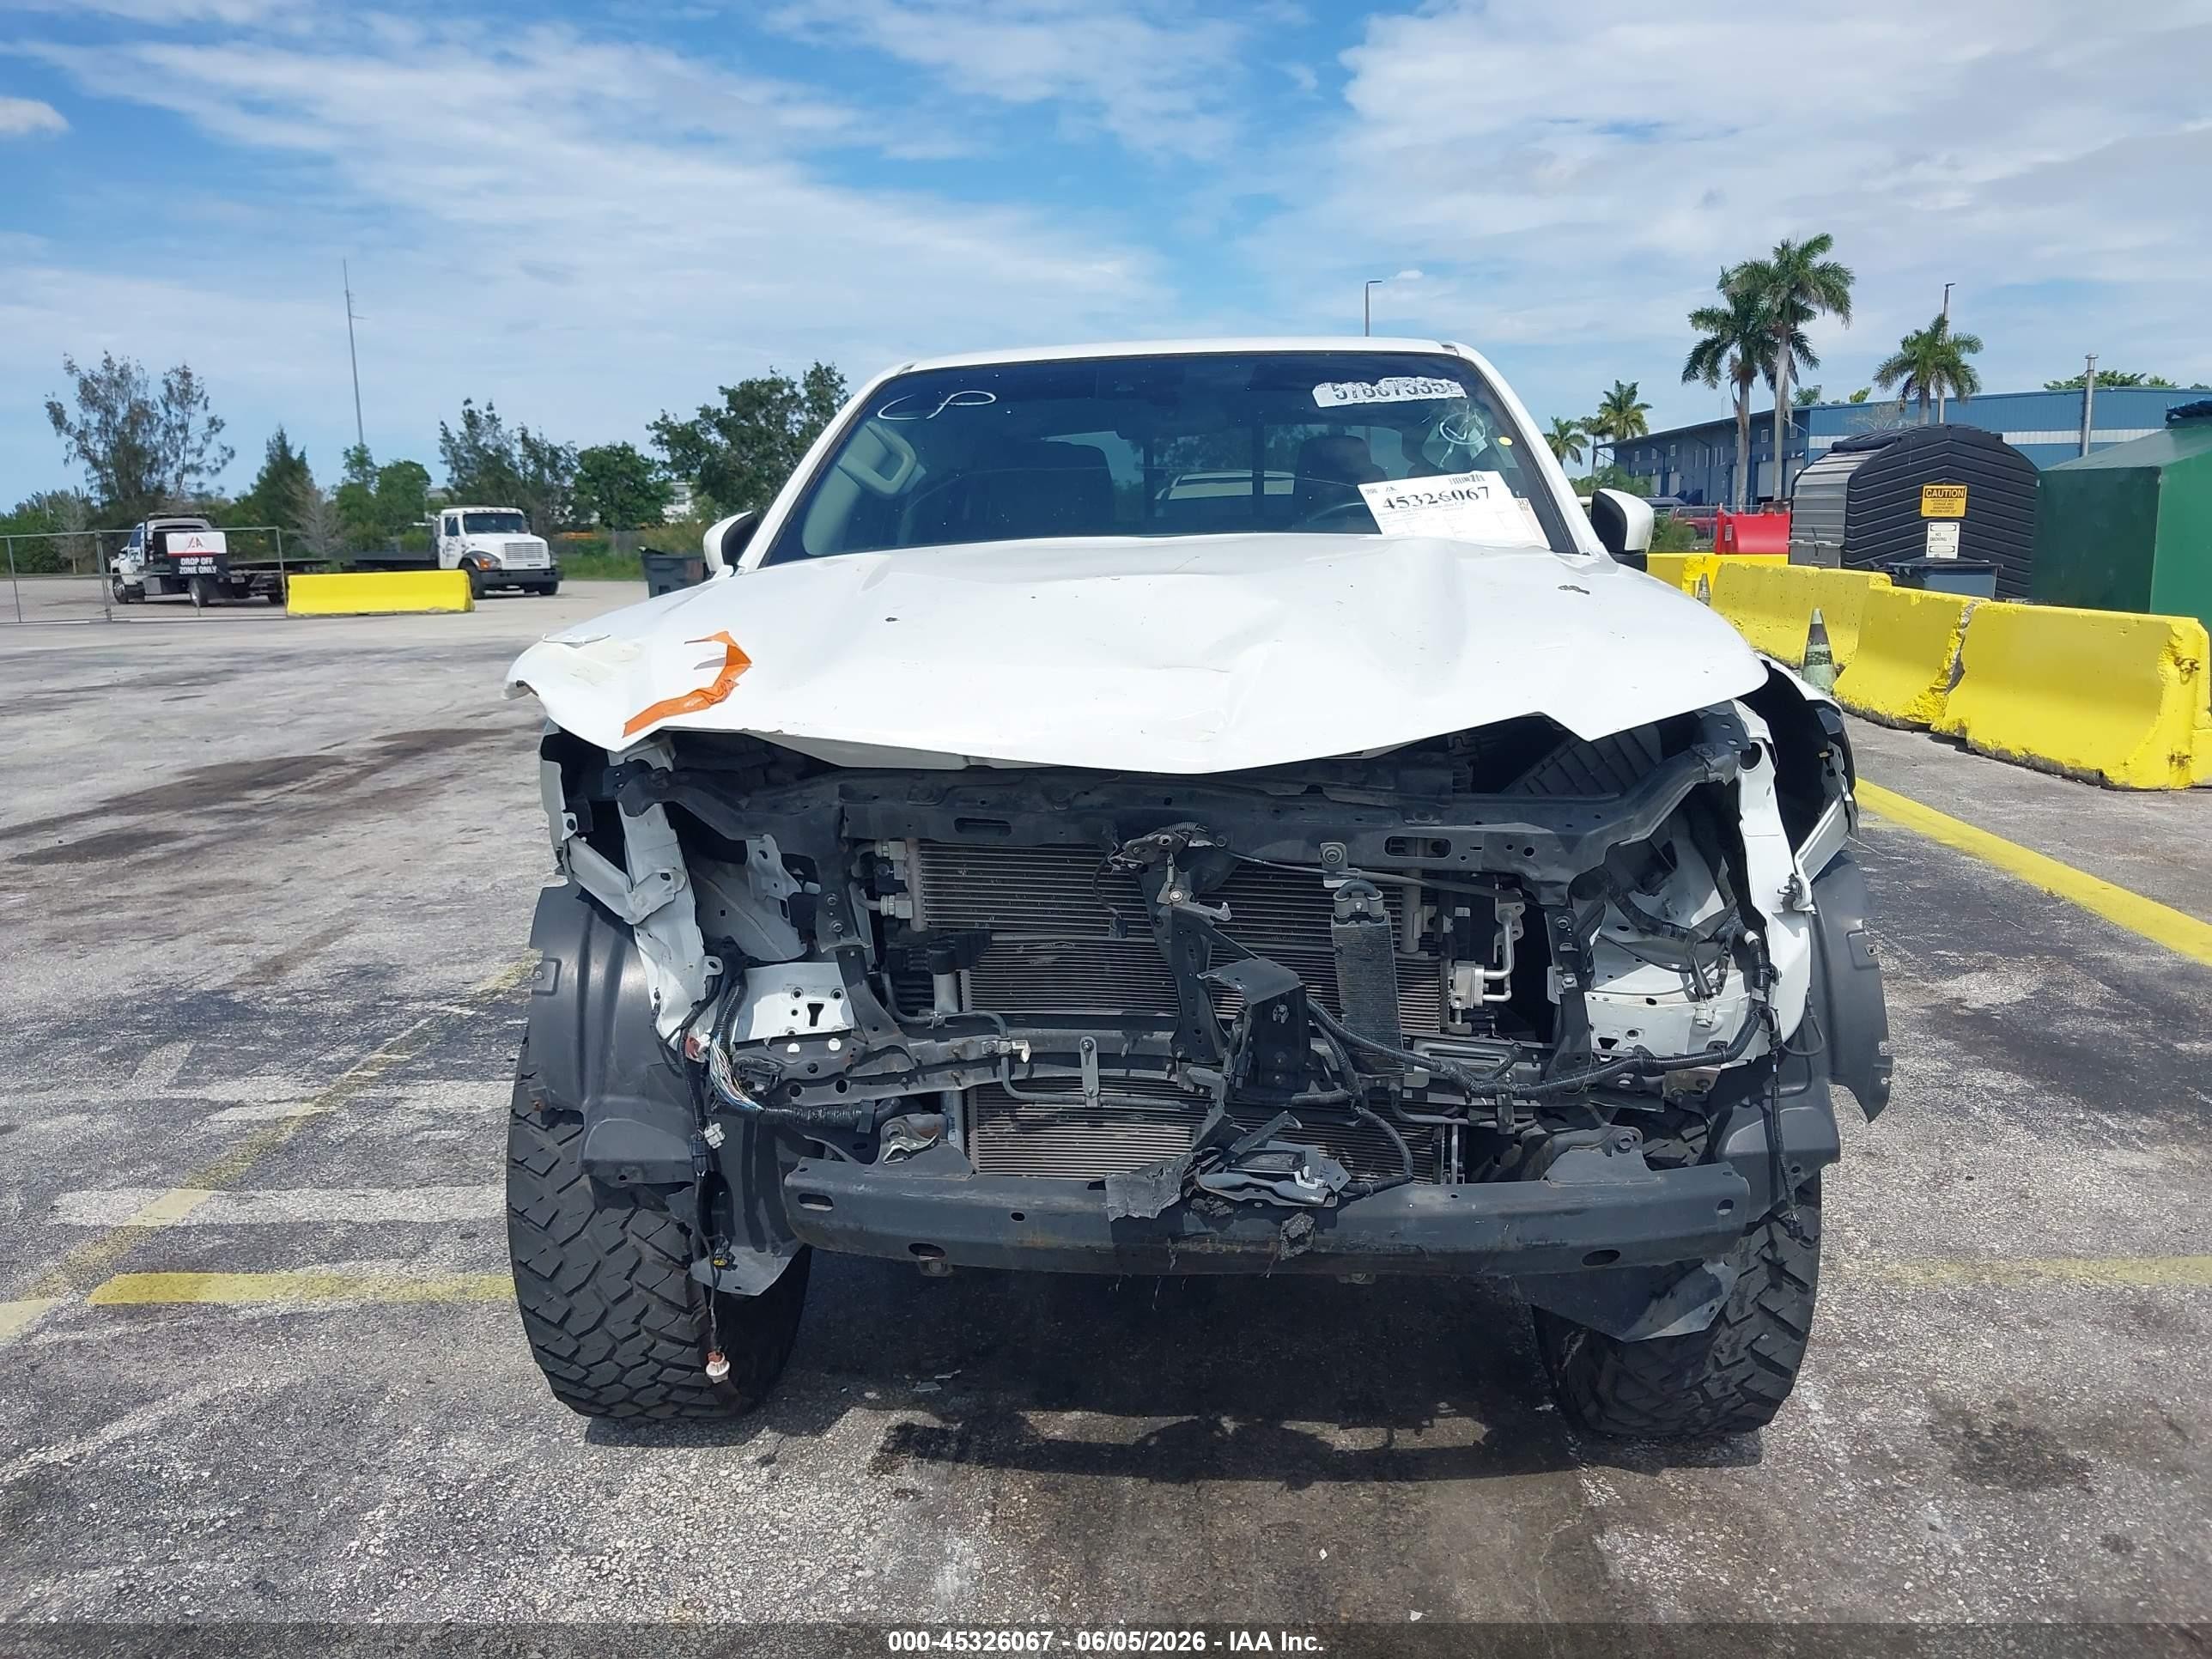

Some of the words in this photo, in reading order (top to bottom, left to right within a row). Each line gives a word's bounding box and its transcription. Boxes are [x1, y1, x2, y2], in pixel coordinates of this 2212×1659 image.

[1925, 489, 1964, 497] CAUTION
[1382, 486, 1490, 510] 45326067
[180, 557, 199, 566] DROP
[200, 556, 214, 566] OFF
[179, 566, 198, 574] ZONE
[198, 565, 217, 574] ONLY
